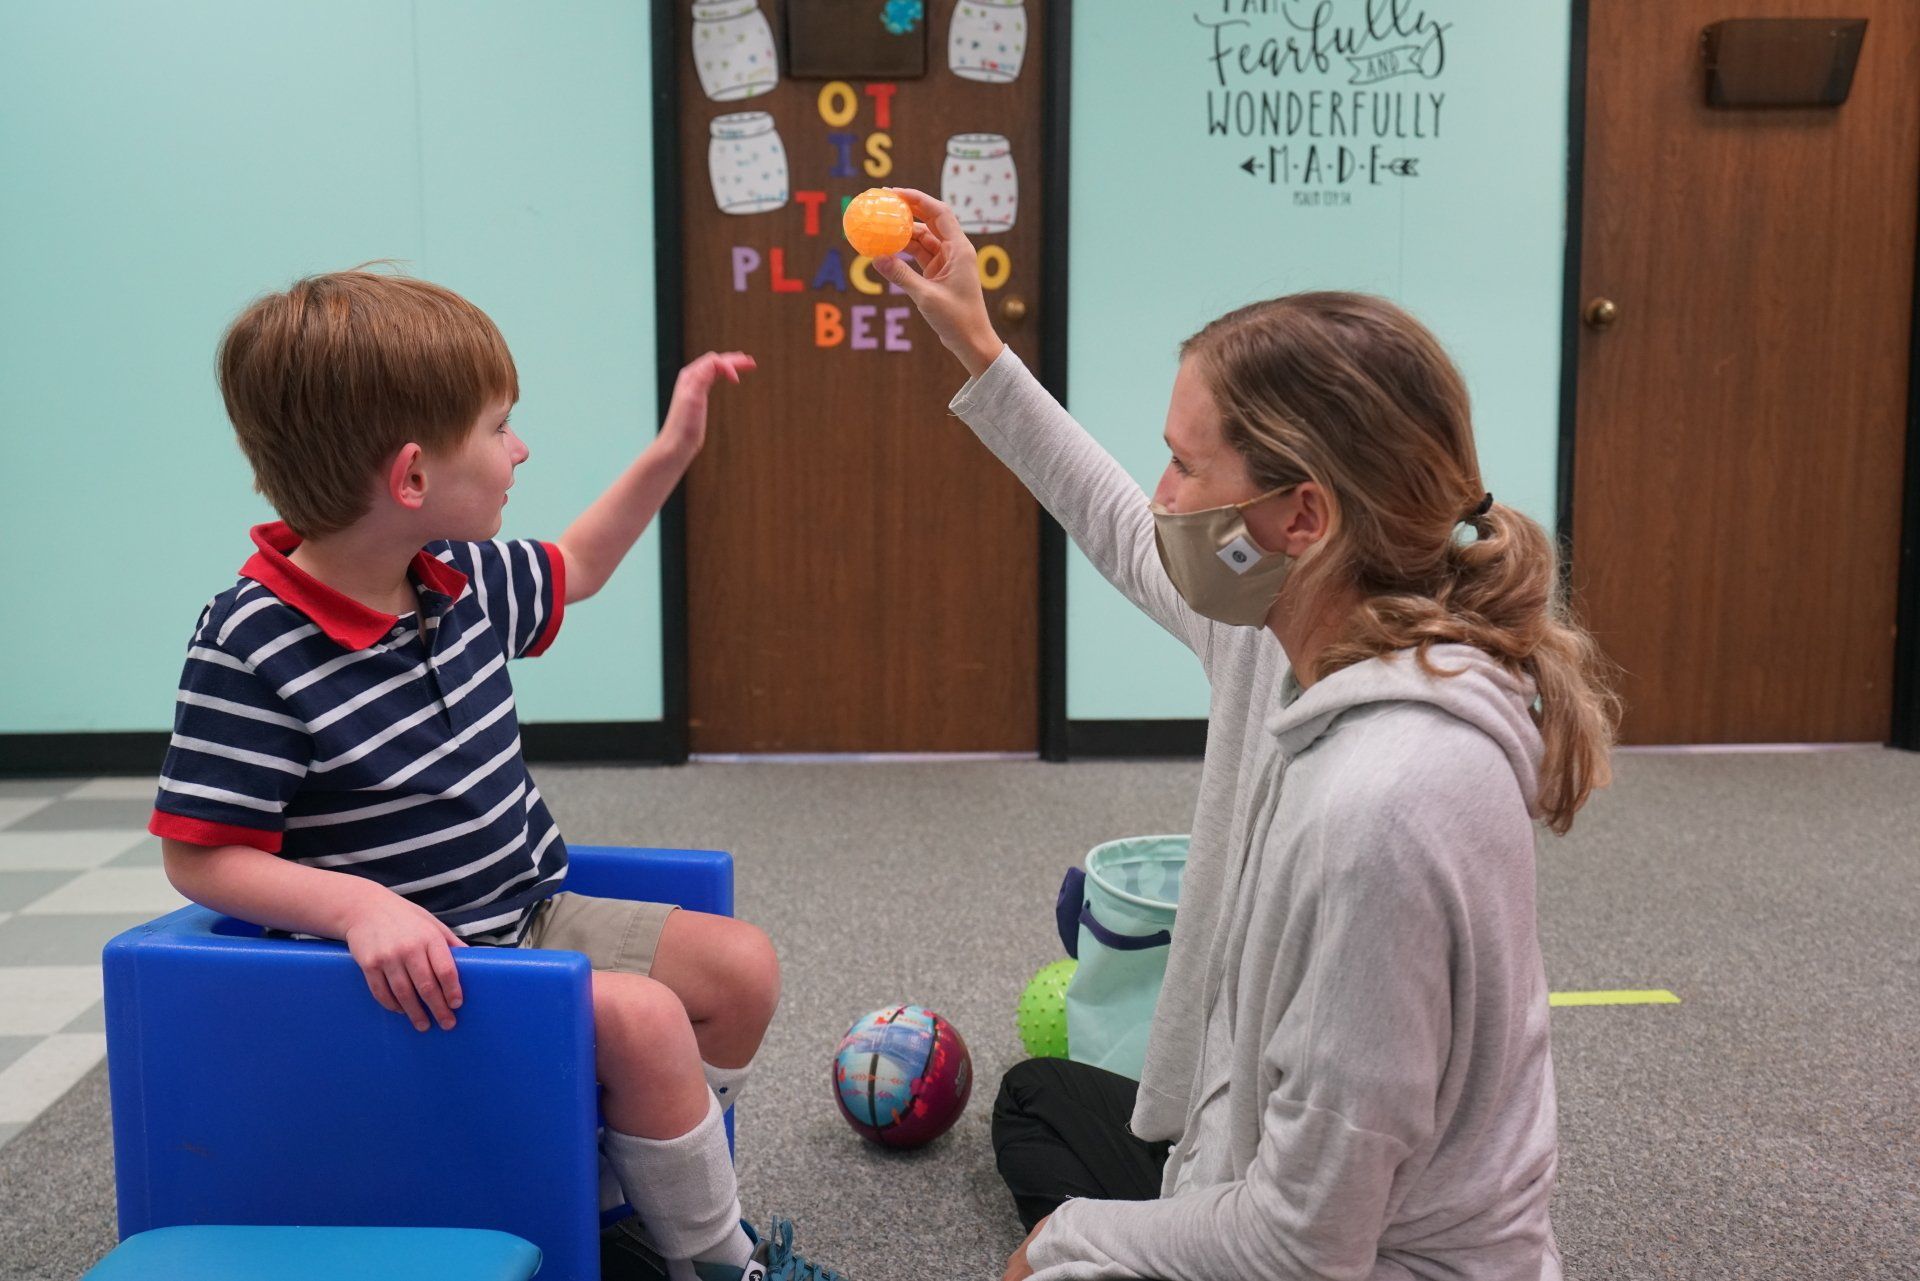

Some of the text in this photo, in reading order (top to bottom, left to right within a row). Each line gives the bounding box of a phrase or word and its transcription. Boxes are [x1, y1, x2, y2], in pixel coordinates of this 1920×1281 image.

[1193, 0, 1452, 86] Fearfully
[1367, 53, 1399, 78] AND
[1208, 90, 1445, 137] WONDERFULLY
[829, 133, 893, 178] IS
[815, 303, 911, 351] BEE
